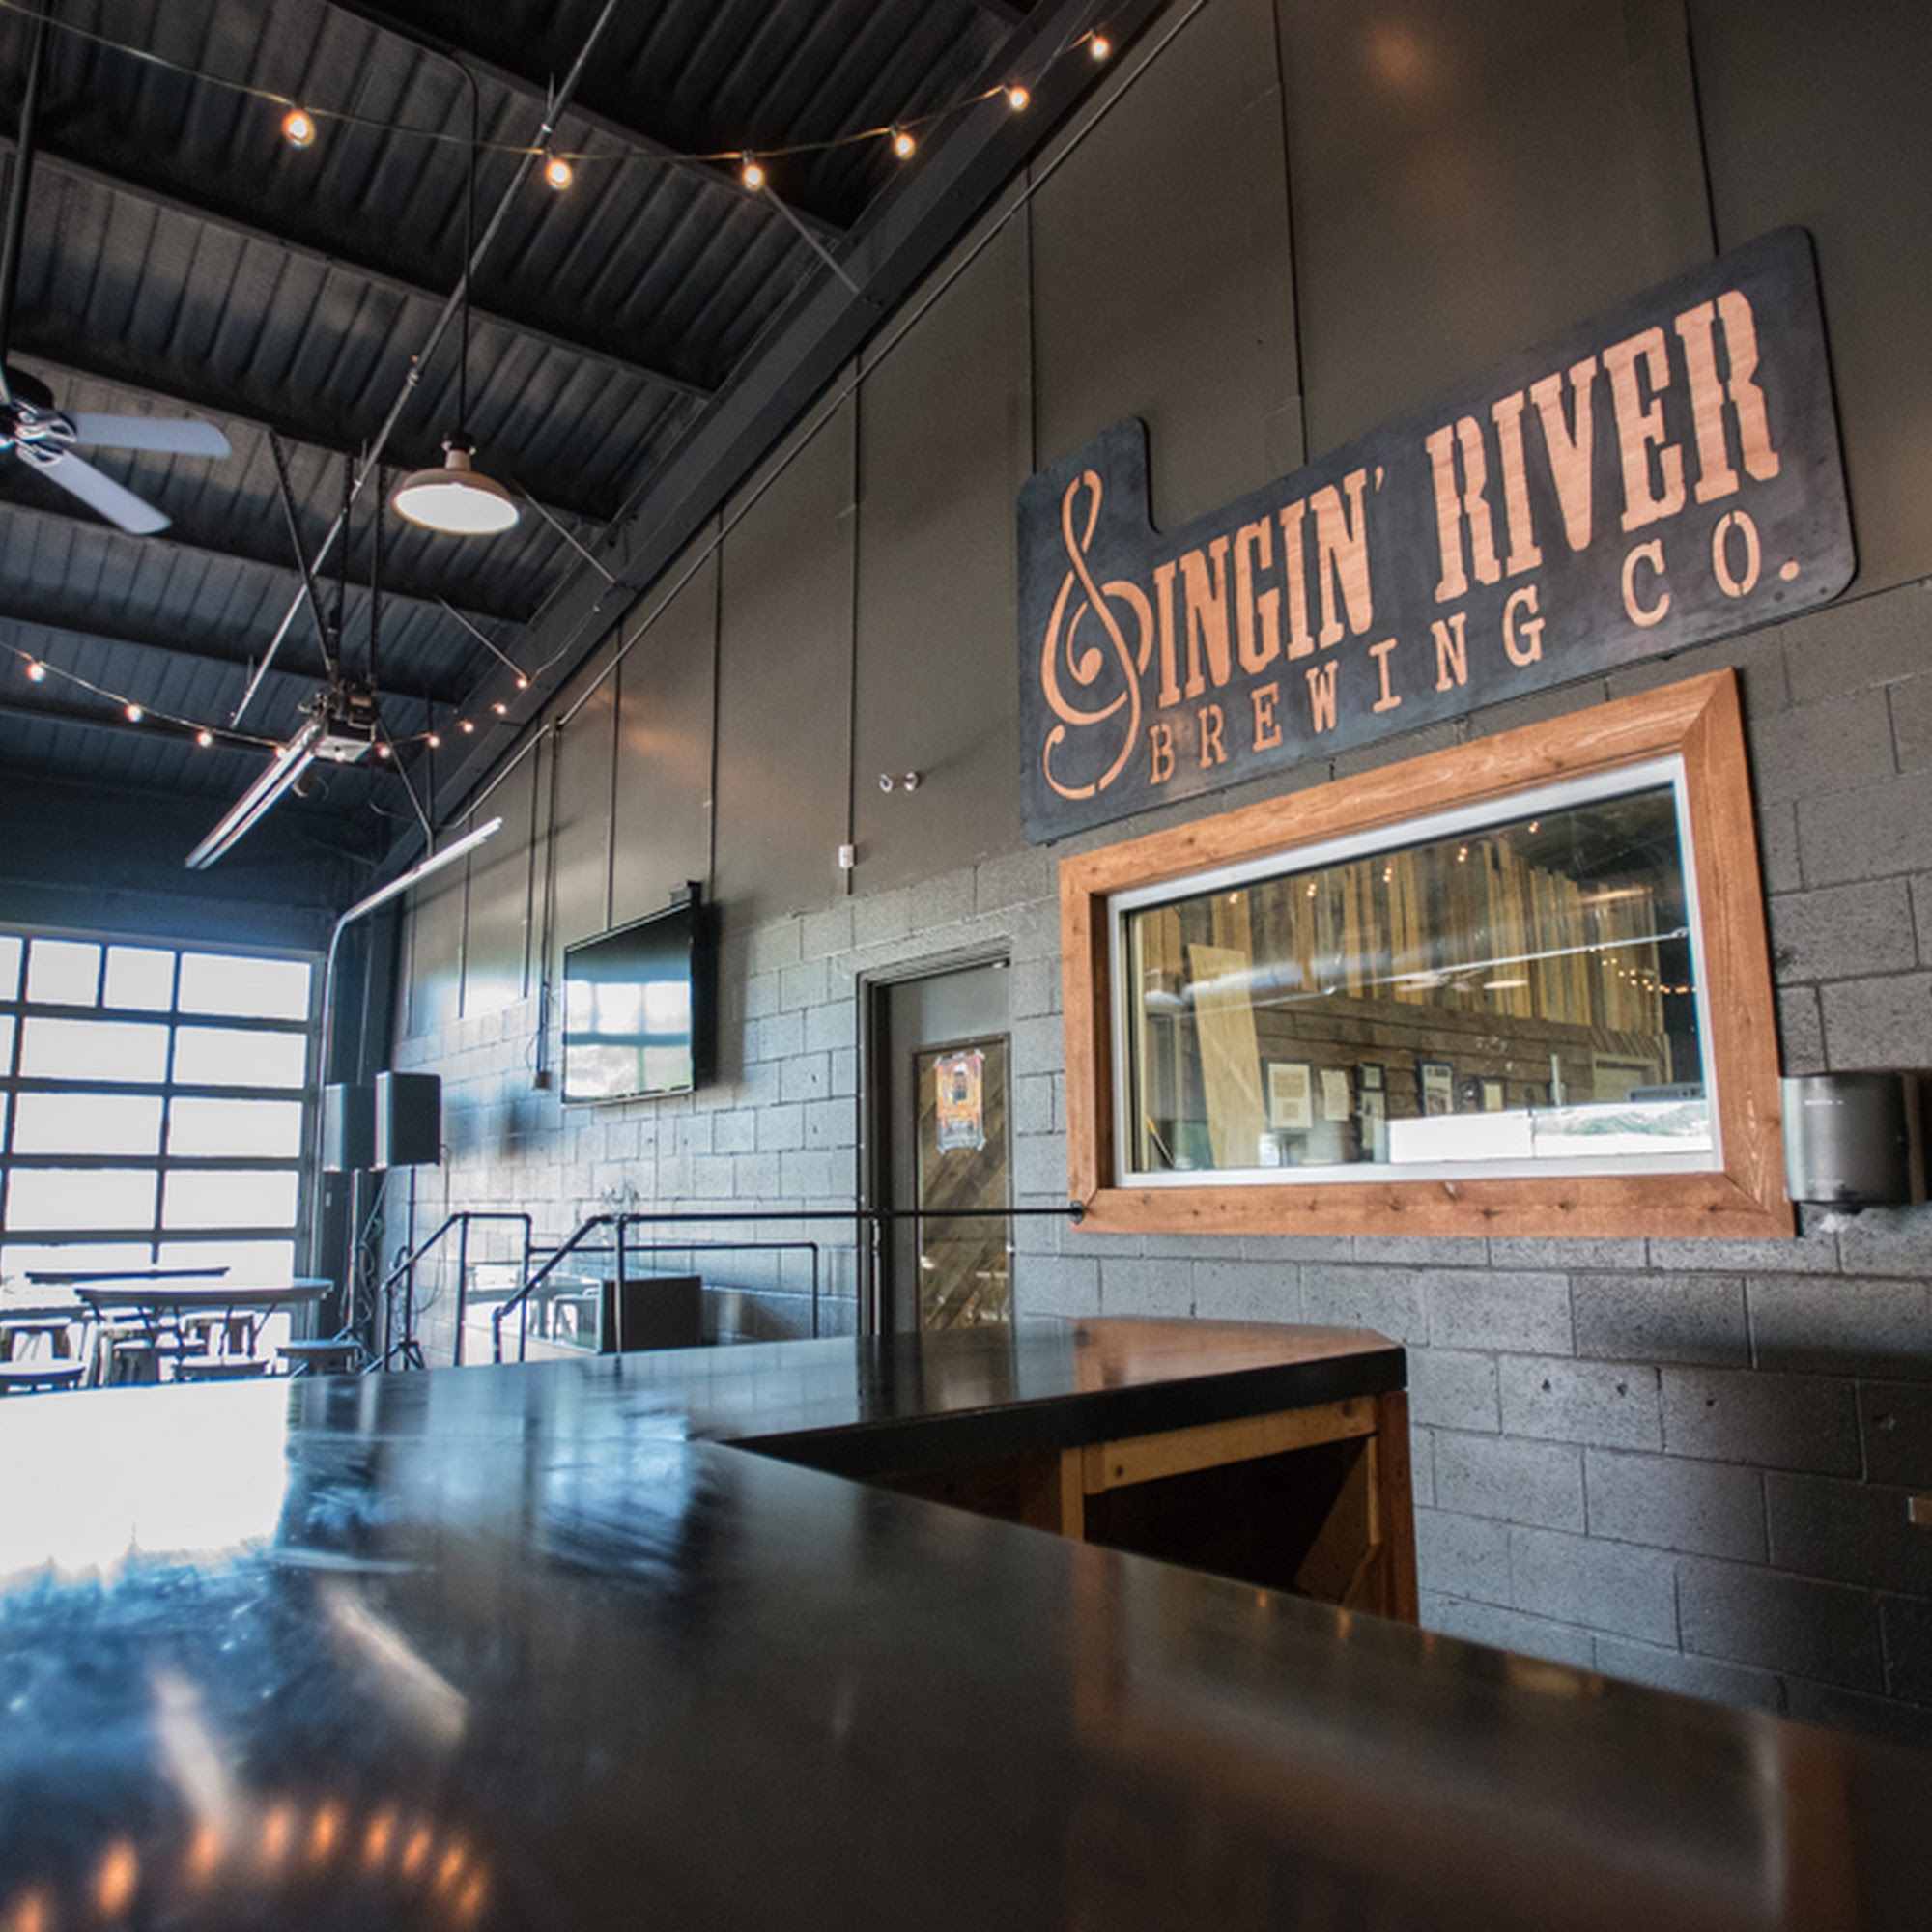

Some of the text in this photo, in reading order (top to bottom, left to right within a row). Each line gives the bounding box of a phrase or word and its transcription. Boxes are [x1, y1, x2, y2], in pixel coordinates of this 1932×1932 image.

[1424, 289, 1780, 603] RIVER
[1148, 510, 1801, 785] BREWING CO.
